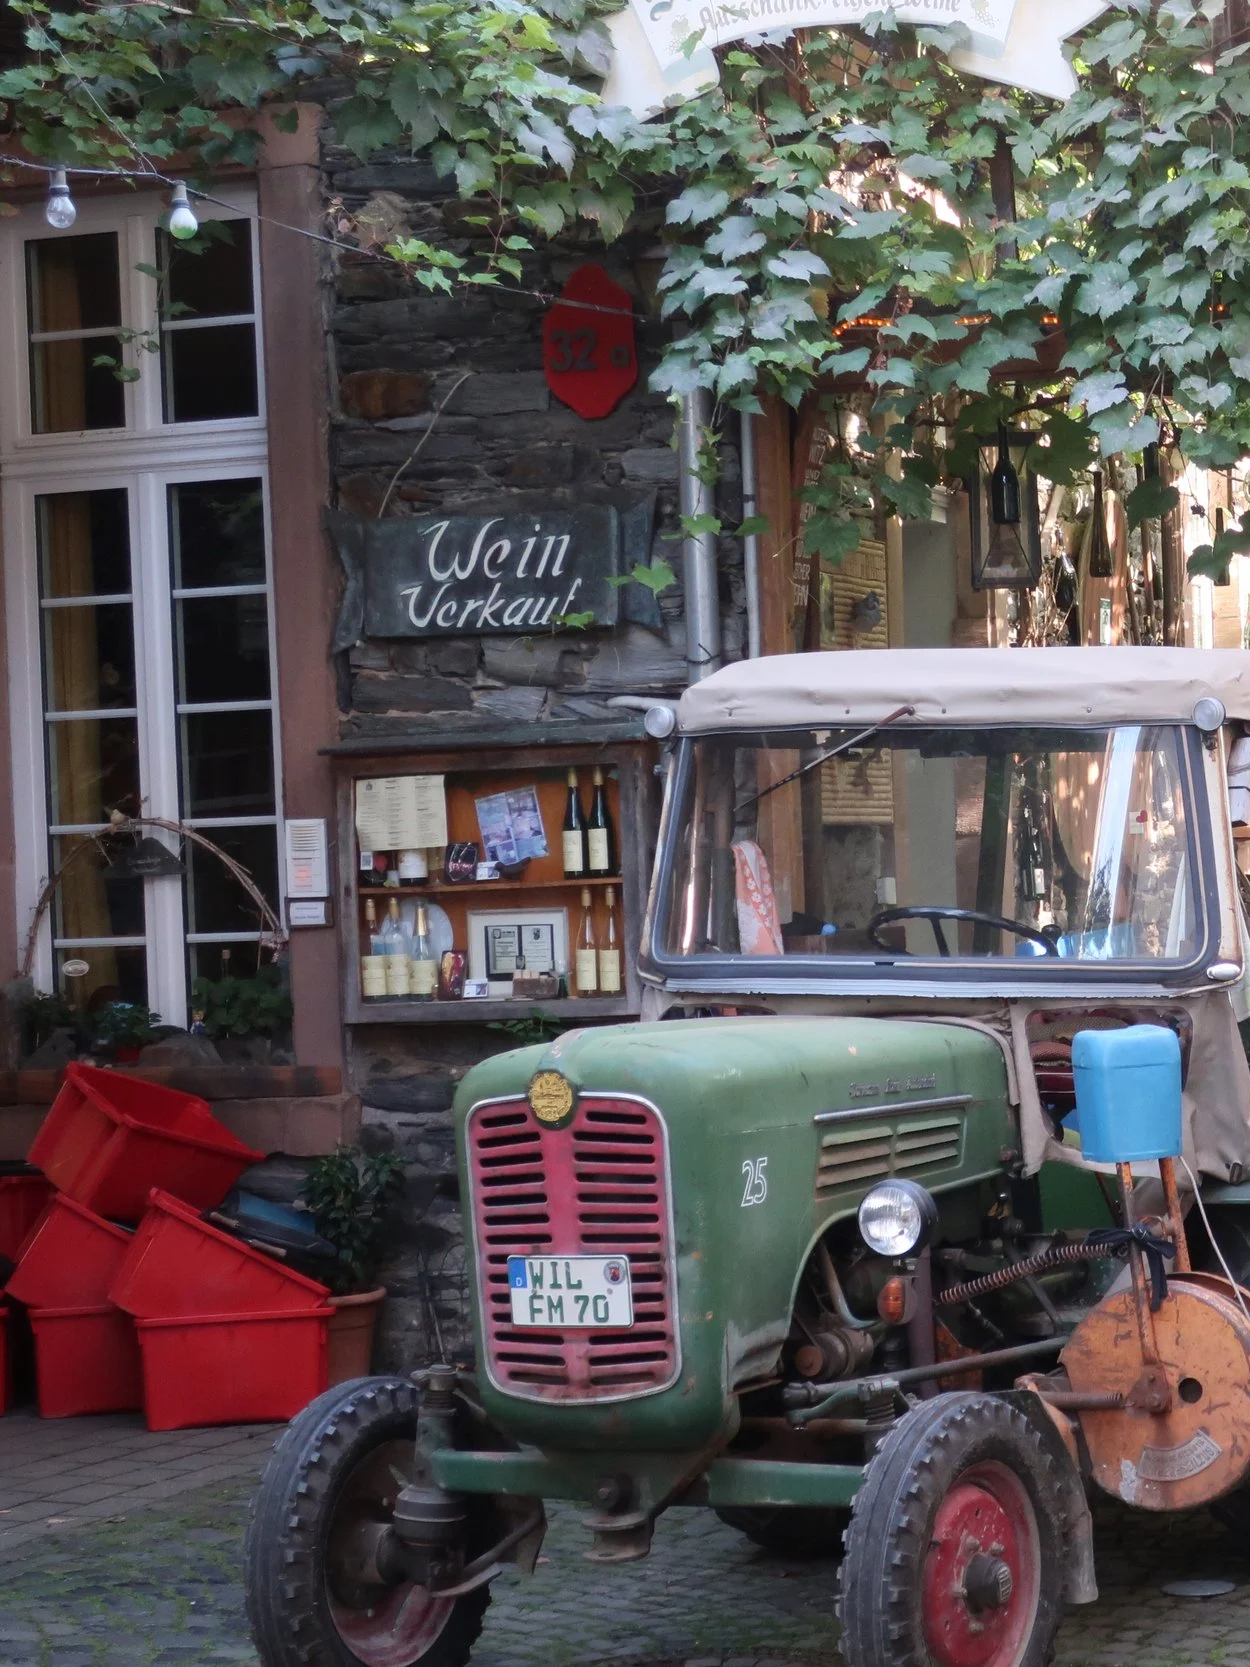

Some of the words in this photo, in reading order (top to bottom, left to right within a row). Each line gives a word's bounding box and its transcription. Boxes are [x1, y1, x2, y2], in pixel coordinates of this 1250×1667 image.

[551, 327, 597, 371] 32
[610, 344, 630, 368] a
[416, 517, 571, 581] Wein
[400, 577, 582, 628] Verkauf
[740, 1156, 768, 1207] 25
[515, 1277, 523, 1287] D
[528, 1261, 583, 1290] WIL
[528, 1294, 565, 1323] FM
[573, 1294, 610, 1323] 70
